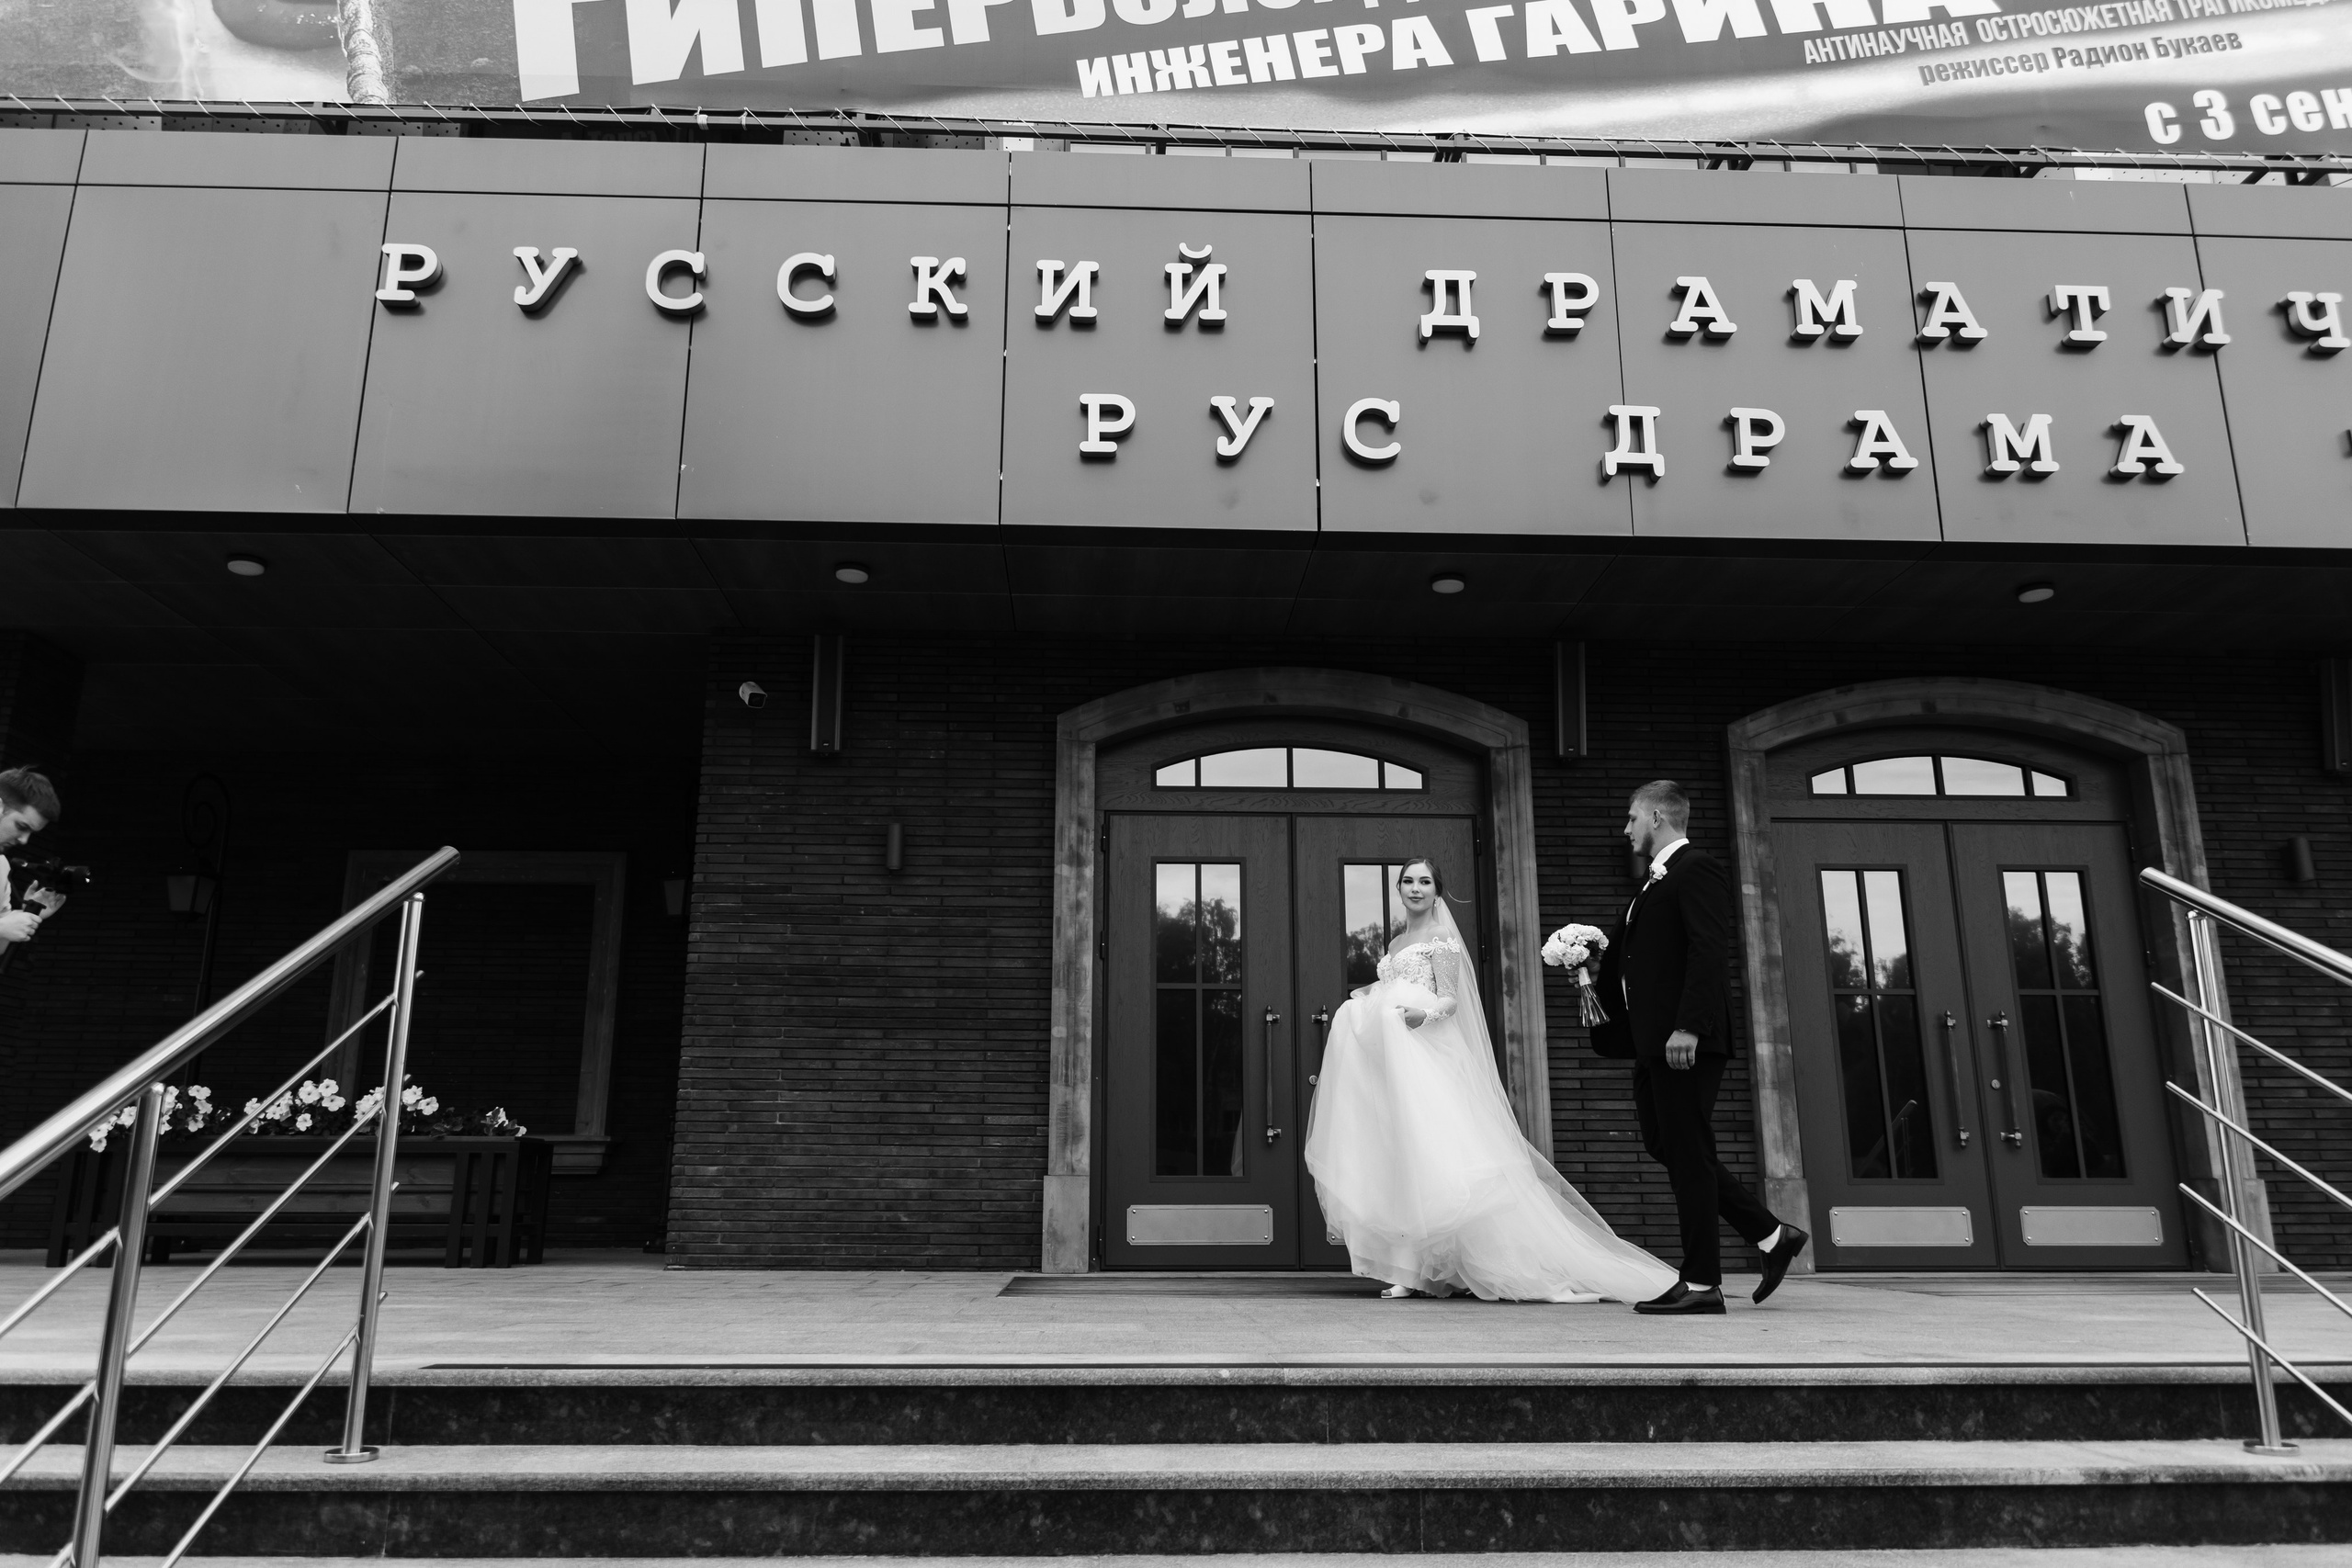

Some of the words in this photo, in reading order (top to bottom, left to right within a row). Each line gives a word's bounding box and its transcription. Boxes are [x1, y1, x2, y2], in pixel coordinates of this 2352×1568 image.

[1076, 15, 1454, 98] ИНЖЕНЕРА
[1465, 0, 2002, 62] ГАРИ
[1803, 21, 1970, 64] АНТИНАУЧНАЯ
[1975, 0, 2174, 43] ОСТРОСЮЖЕТНАЯ
[1917, 51, 2050, 86] режиссер
[2052, 41, 2149, 70] Радион
[2151, 32, 2243, 60] Букаев
[2143, 102, 2182, 145] с
[2192, 89, 2235, 141] 3
[375, 241, 1228, 328] РУССКИЙ
[1418, 268, 2352, 353] ДРАМАТИЧ
[1078, 392, 1403, 465] РУС
[1600, 403, 2186, 481] ДРАМА
